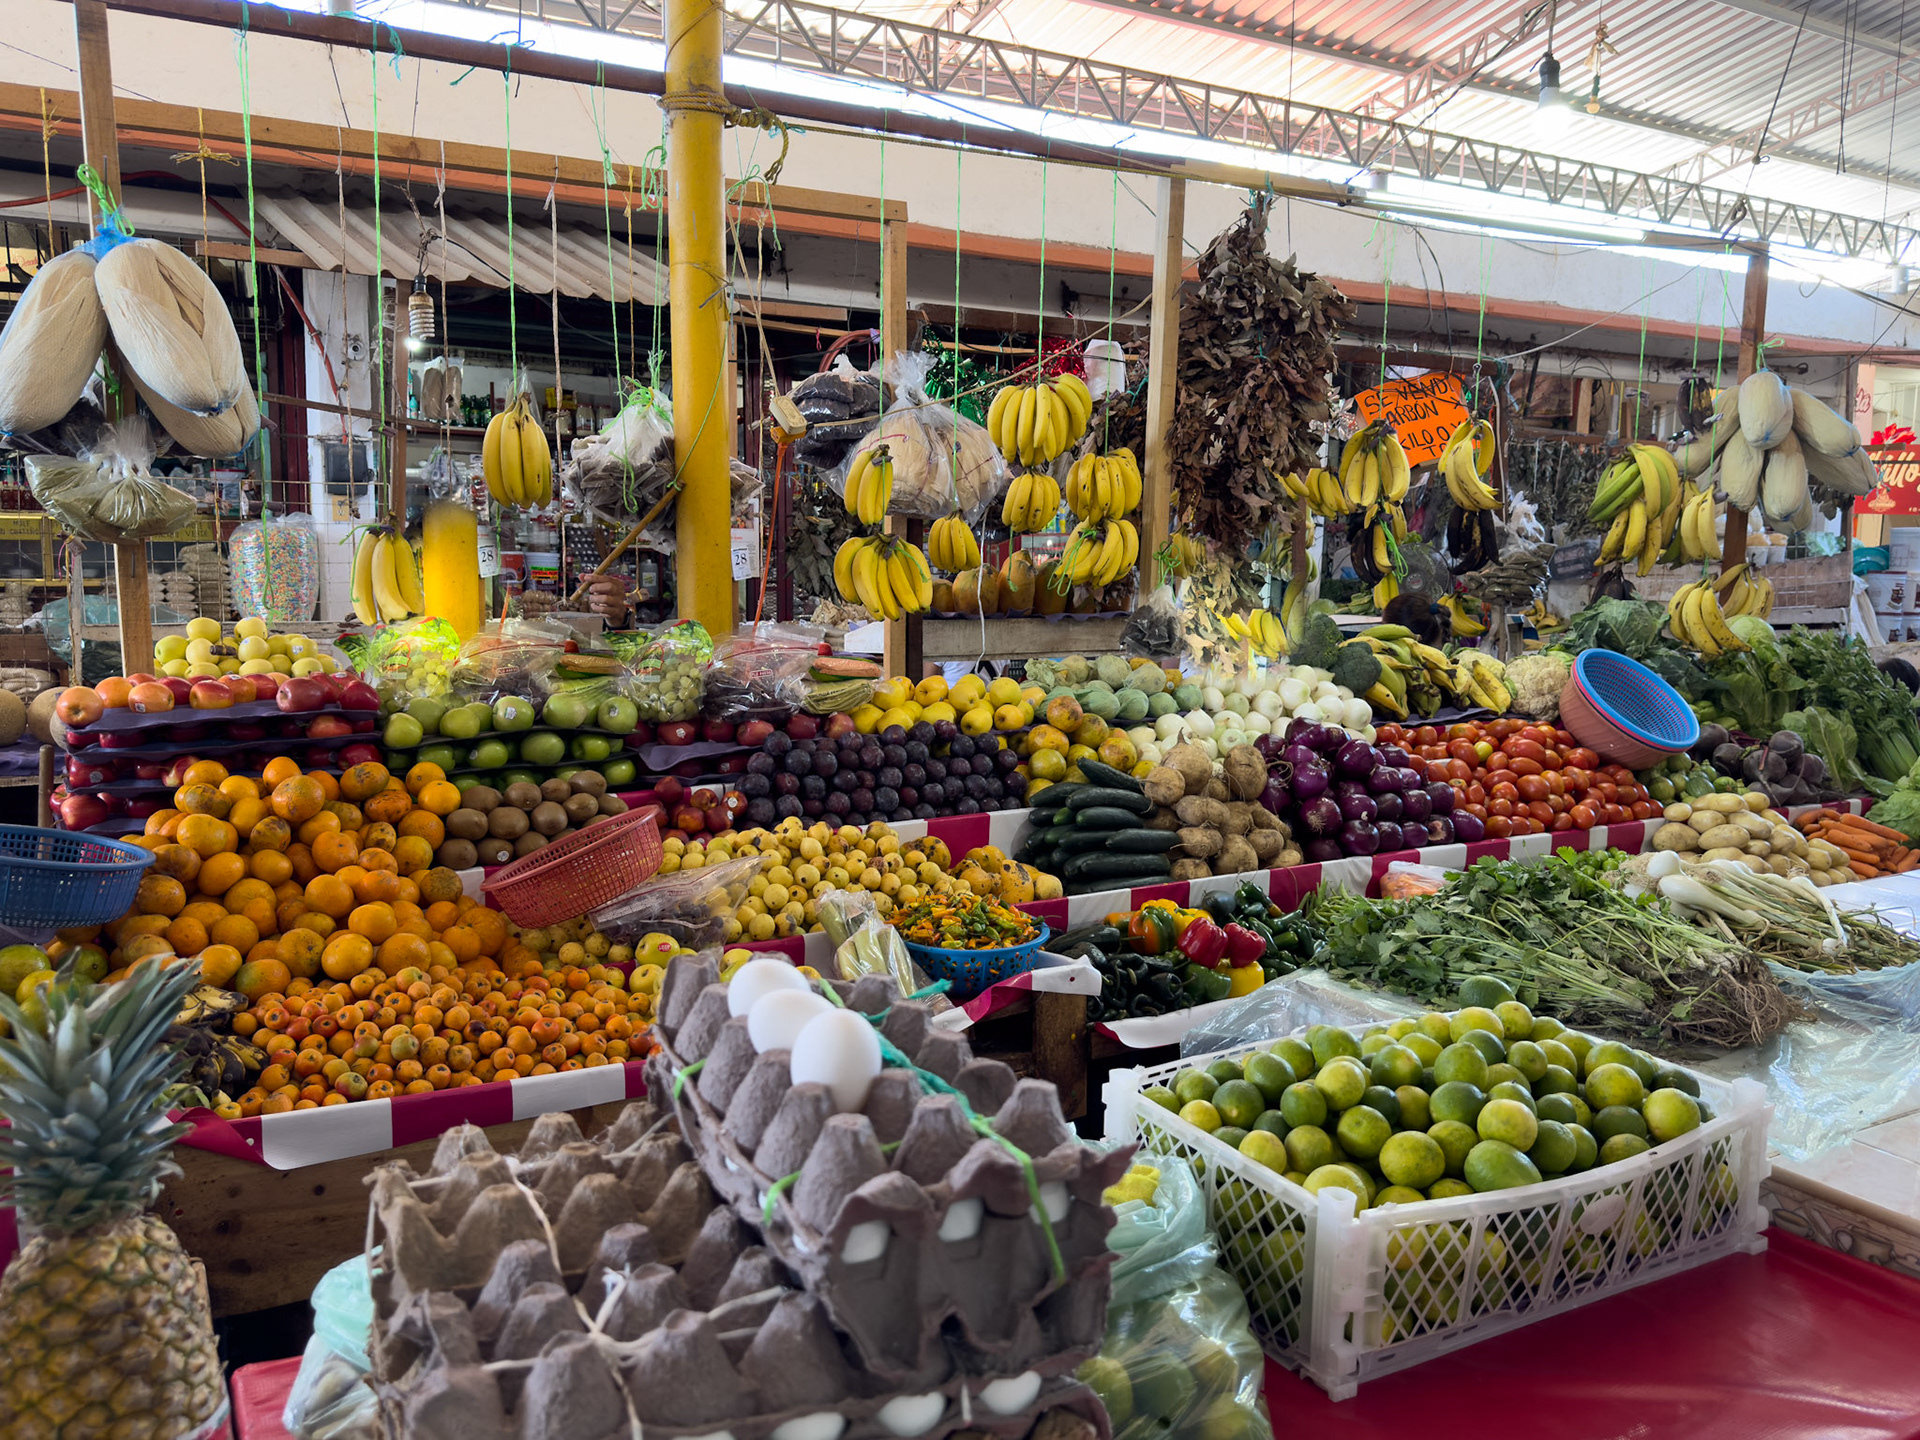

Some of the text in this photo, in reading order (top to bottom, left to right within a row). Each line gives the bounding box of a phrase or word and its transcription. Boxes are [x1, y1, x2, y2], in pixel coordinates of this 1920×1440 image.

[1364, 378, 1455, 415] SE VEND
[1385, 400, 1439, 425] ARBÓN
[481, 550, 494, 562] 28
[735, 553, 748, 566] 28
